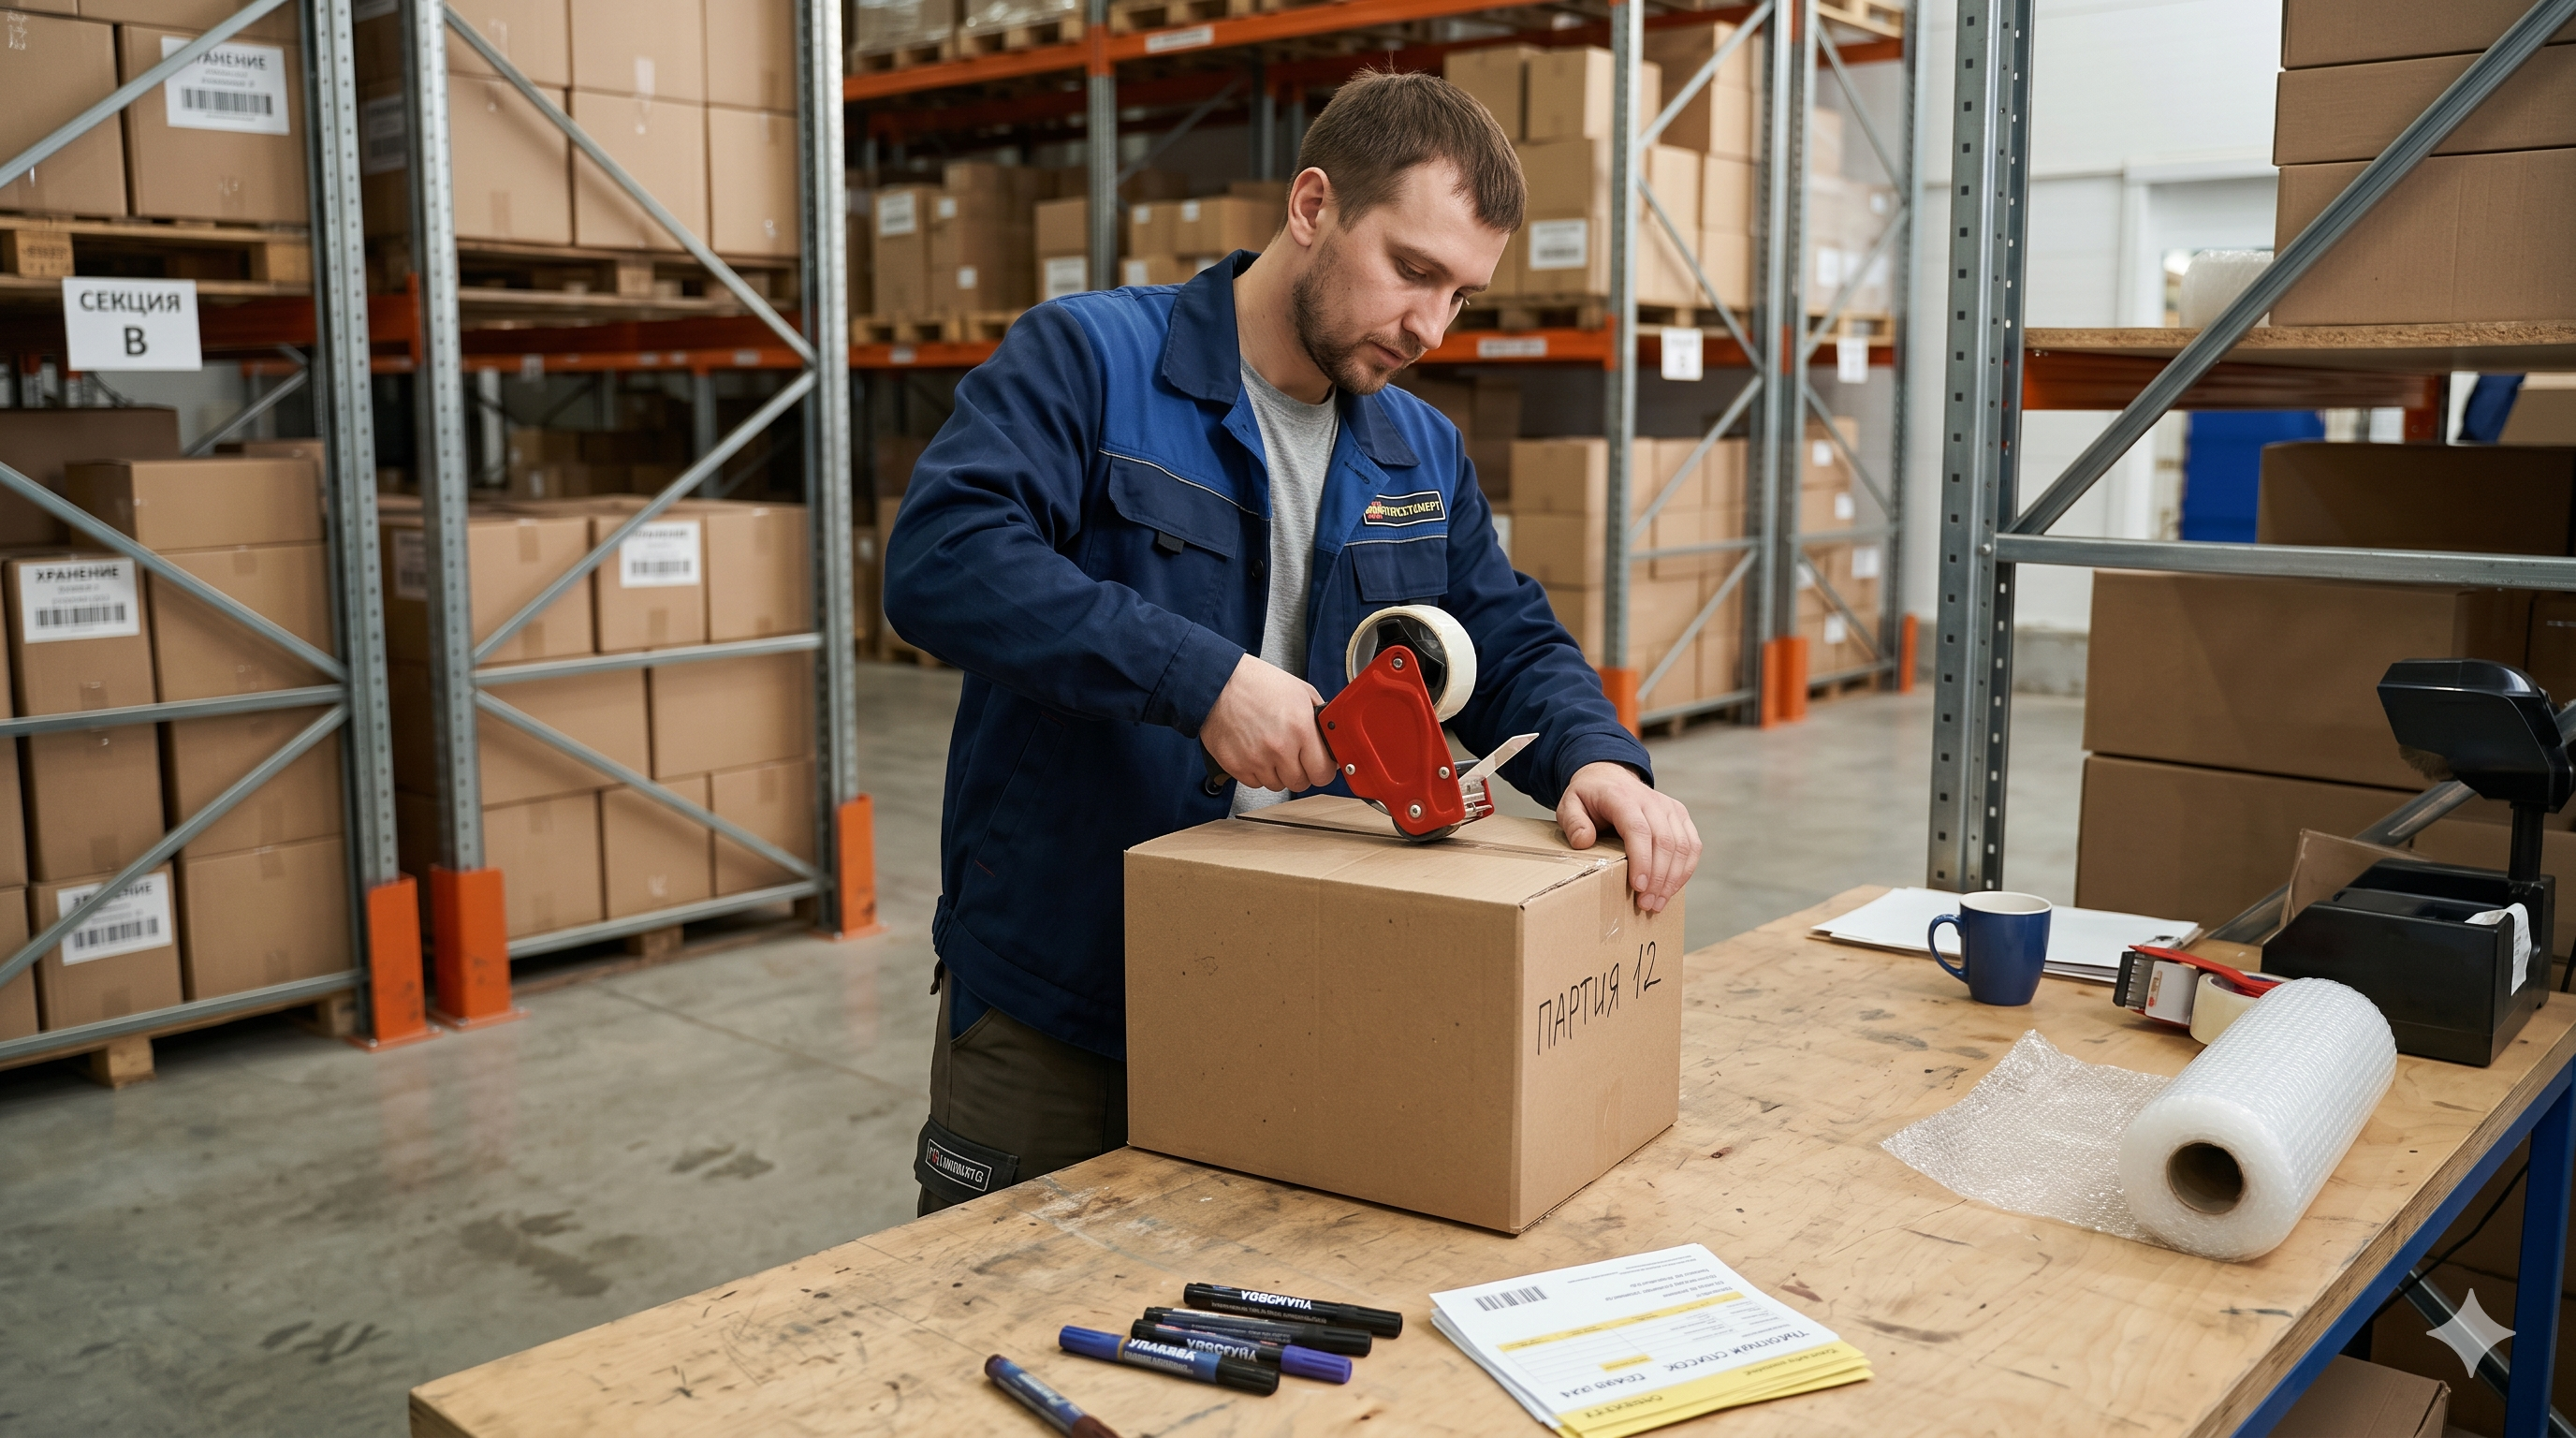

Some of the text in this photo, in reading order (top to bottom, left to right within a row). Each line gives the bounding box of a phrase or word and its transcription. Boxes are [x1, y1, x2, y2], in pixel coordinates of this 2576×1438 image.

[80, 290, 181, 316] СЕКЦИЯ
[124, 326, 148, 358] В
[37, 567, 119, 582] ХРАНЕНИЕ
[1537, 941, 1661, 1056] ПАРТИЯ 12
